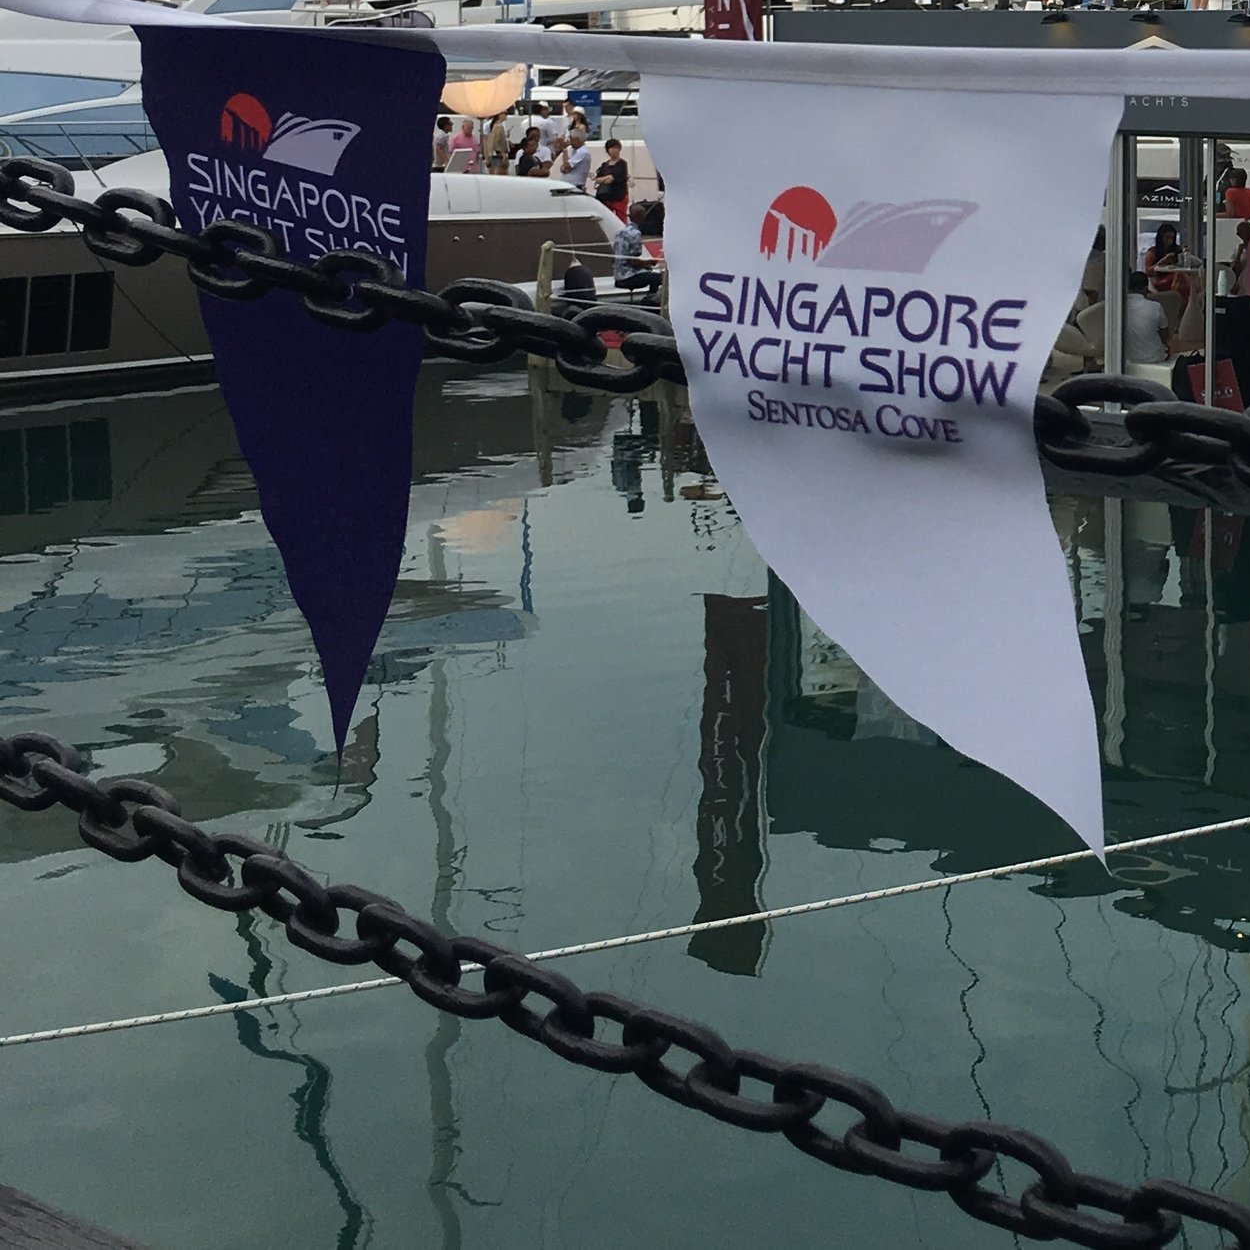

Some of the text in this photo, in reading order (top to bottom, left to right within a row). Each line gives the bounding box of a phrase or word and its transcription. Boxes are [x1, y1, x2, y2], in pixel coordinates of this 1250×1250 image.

[1128, 96, 1190, 108] ACHTS
[187, 152, 406, 244] SINGAPORE
[1141, 194, 1193, 203] AZIMUT
[693, 271, 1028, 352] SINGAPORE
[692, 326, 1018, 407] YACHT SHOW
[747, 389, 964, 444] SENTOSA COVE
